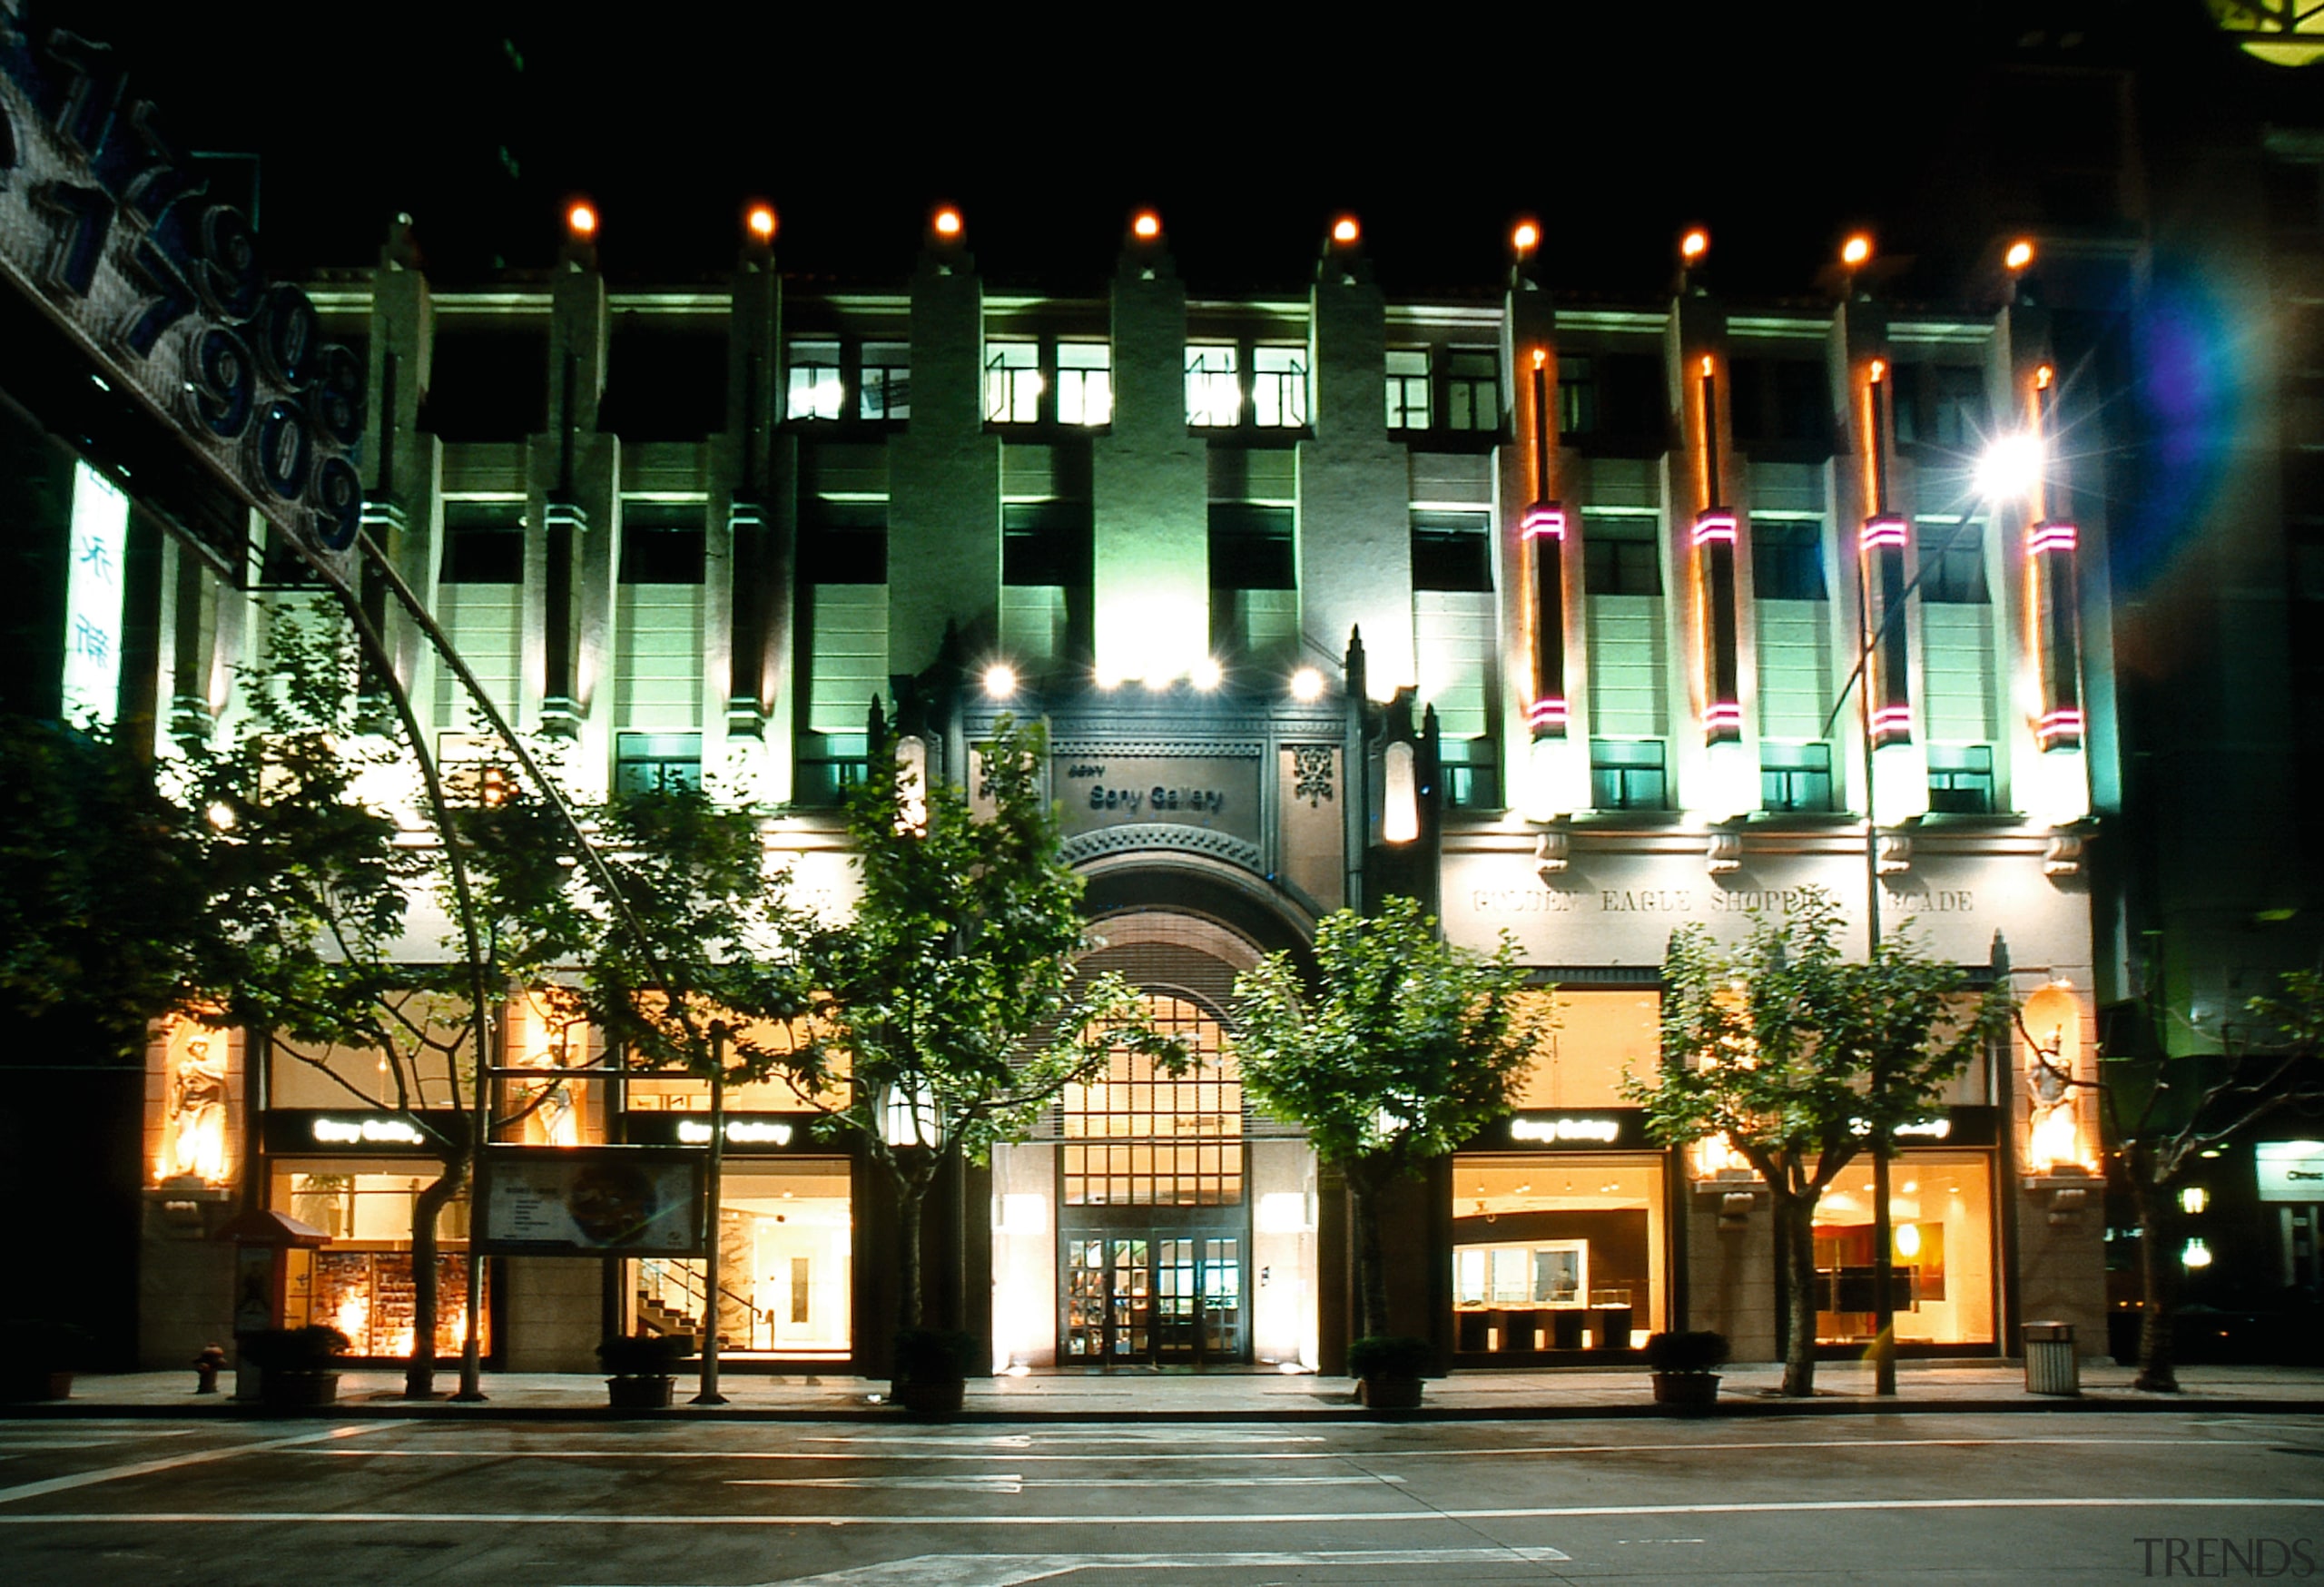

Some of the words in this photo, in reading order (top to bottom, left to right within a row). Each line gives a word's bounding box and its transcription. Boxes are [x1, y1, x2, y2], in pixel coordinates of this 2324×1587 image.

[1150, 785, 1223, 813] Gallery
[1600, 891, 1692, 912] EAGLE
[1876, 891, 1974, 912] RCADE
